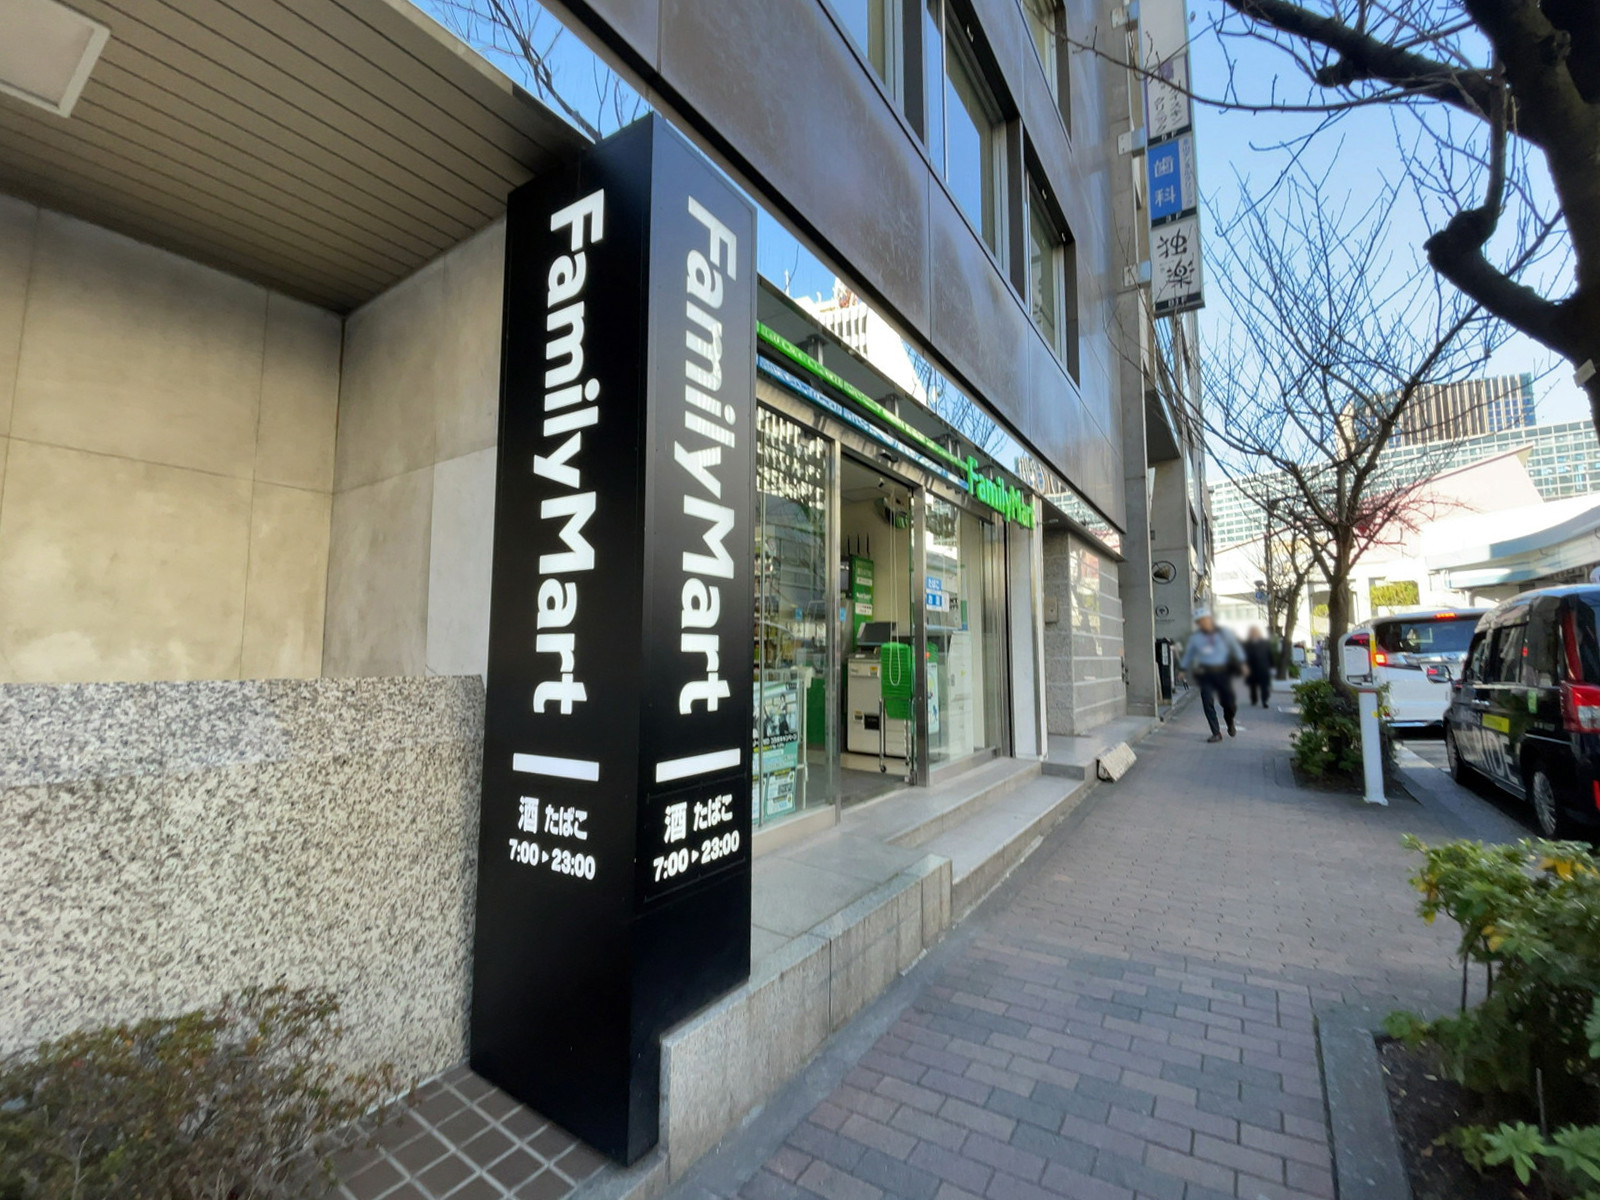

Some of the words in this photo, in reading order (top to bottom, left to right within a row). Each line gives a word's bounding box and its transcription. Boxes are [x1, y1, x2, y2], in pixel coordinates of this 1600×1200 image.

[1154, 155, 1176, 208] 歯科
[532, 188, 604, 716] FamilyMart
[674, 195, 737, 716] FamilyMart
[518, 795, 540, 834] 酒
[544, 803, 588, 841] たばこ
[663, 801, 687, 844] 酒
[693, 793, 733, 832] たばこ
[508, 838, 539, 866] 7:00
[551, 847, 596, 881] 23:00
[653, 847, 689, 882] 7:00
[701, 829, 740, 864] 23:00
